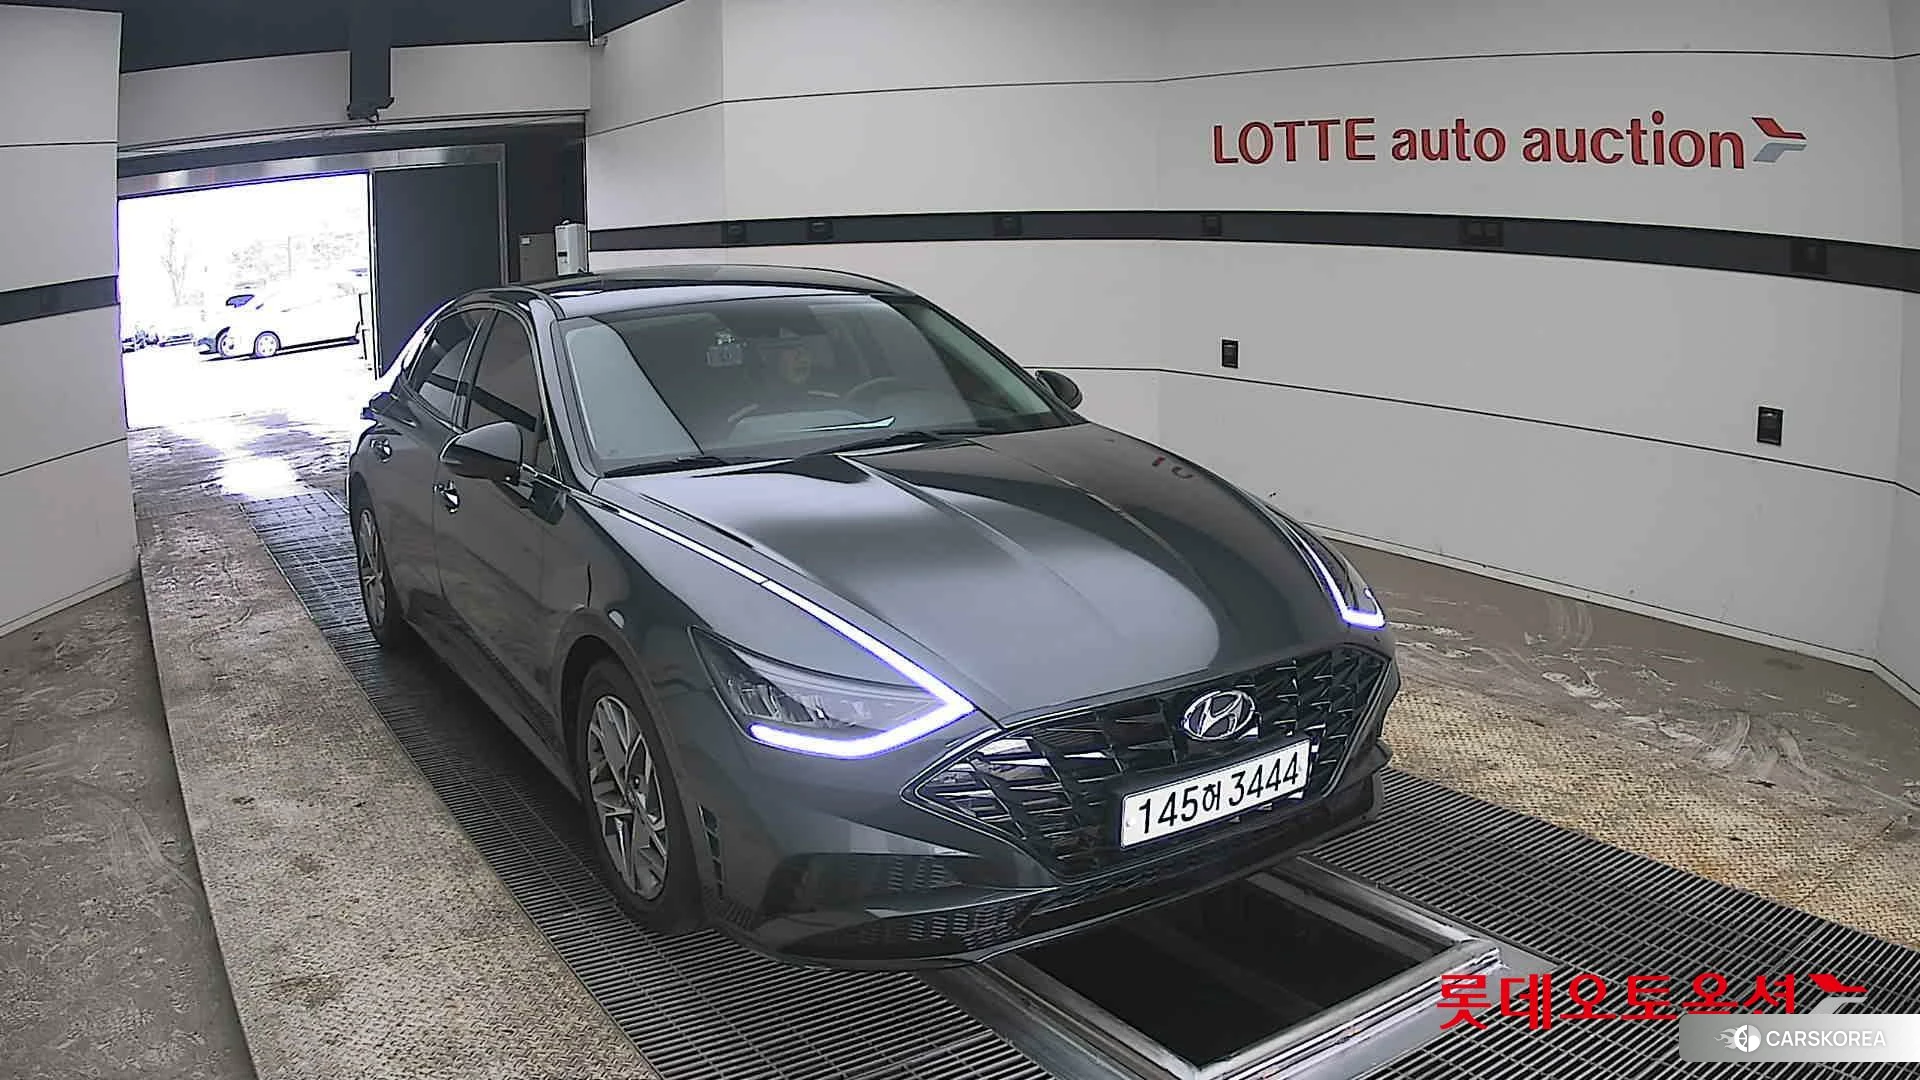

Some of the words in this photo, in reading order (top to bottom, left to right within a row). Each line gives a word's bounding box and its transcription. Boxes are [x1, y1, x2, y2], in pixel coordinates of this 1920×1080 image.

[1212, 117, 1376, 164] LOTTE
[1391, 117, 1507, 162] auto
[1523, 110, 1745, 169] auction
[1138, 780, 1222, 834] 145허
[1228, 751, 1299, 807] 3444
